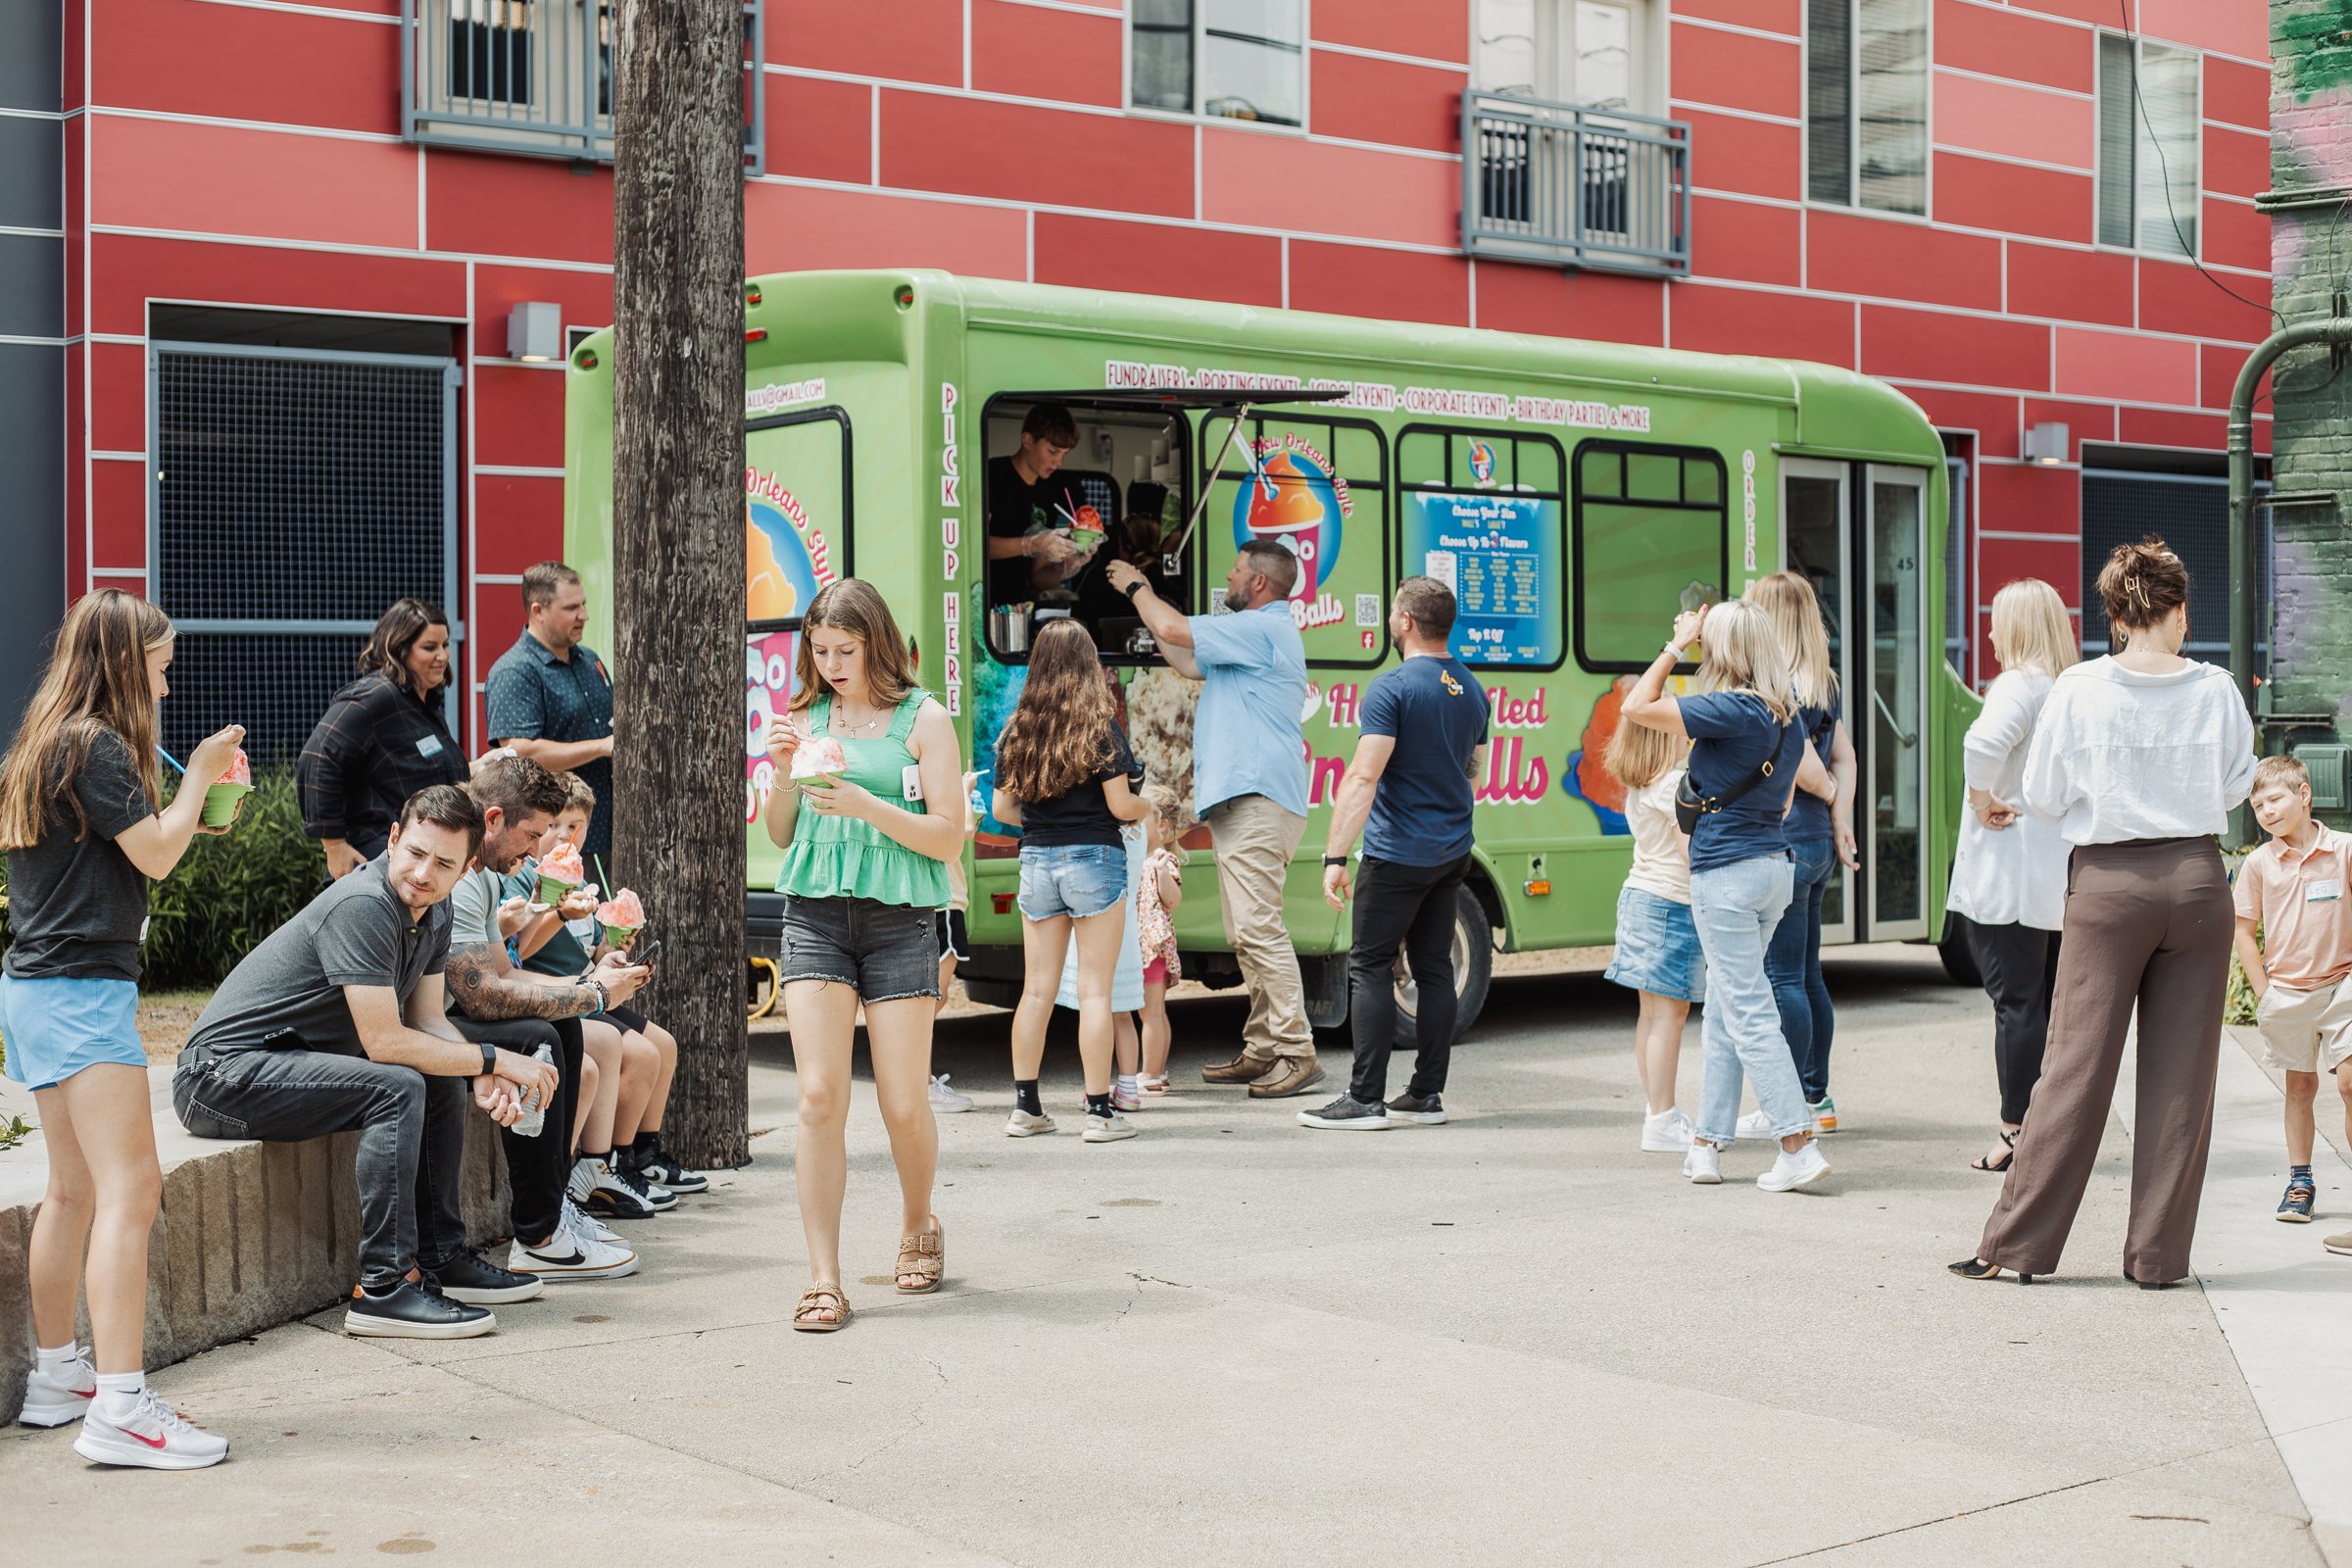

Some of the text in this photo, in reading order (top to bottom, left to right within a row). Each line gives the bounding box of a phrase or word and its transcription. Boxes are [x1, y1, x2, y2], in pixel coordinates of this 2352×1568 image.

[1356, 385, 1394, 408] EVENTS
[1405, 390, 1467, 414] CORPORATE
[1471, 394, 1507, 416] EVENTS
[1518, 399, 1565, 421] BIRTHDAY
[1569, 404, 1607, 425] PARTIES
[1610, 409, 1618, 426] &
[1621, 409, 1648, 428] MORE
[1286, 432, 1335, 476] Orleans
[1333, 477, 1354, 519] Style
[1743, 451, 1755, 569] ORDER
[746, 466, 840, 590] Orleans Styl
[944, 384, 959, 714] PICK UP HERE
[1897, 557, 1914, 571] 45
[1290, 593, 1345, 630] Balls
